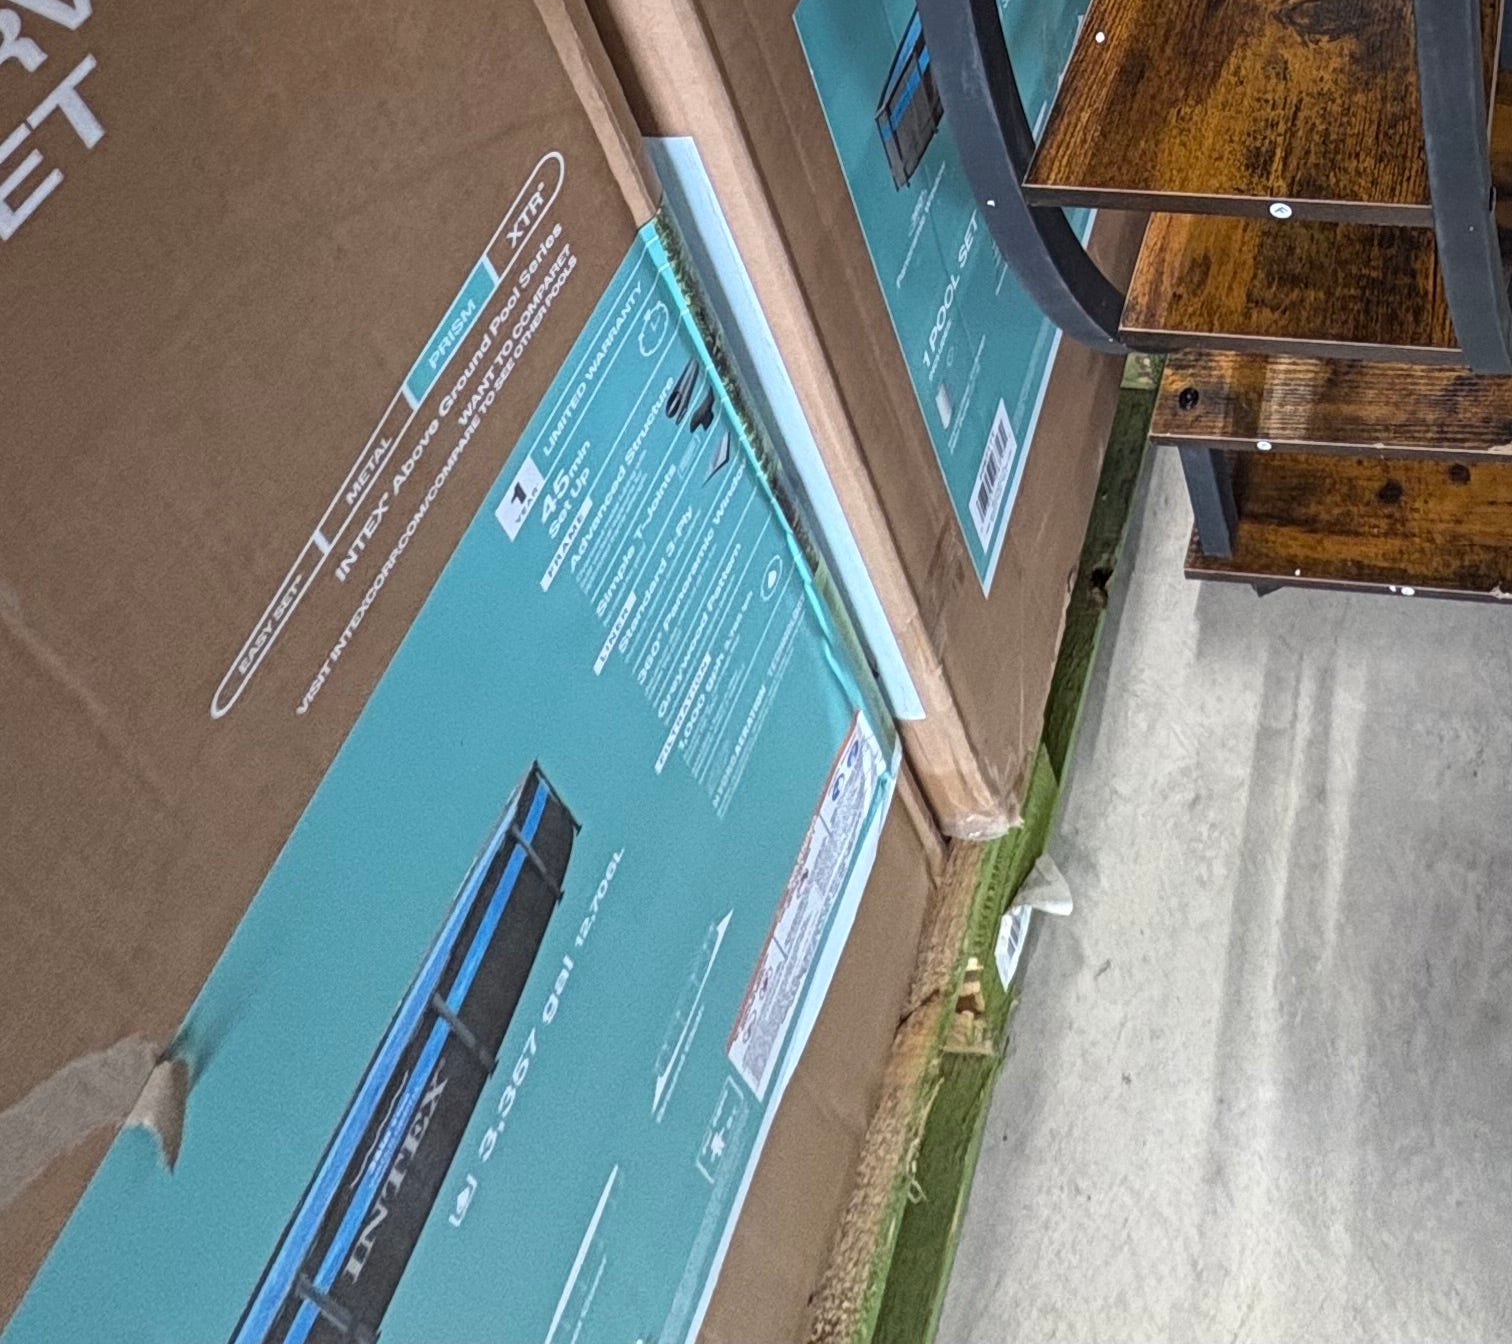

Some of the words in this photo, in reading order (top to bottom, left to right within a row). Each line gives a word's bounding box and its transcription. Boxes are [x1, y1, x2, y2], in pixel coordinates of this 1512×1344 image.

[506, 188, 544, 248] XTR
[929, 273, 960, 348] POOL
[958, 209, 979, 267] SET
[429, 298, 477, 369] PRISM
[458, 367, 496, 427] WANT
[493, 340, 514, 367] TO
[512, 244, 571, 339] COMPARE?
[543, 382, 587, 457] LIMITED
[584, 279, 643, 380] WARRANTY
[335, 496, 389, 582] INTEX
[393, 419, 440, 496] Above
[438, 333, 492, 417] Ground
[489, 286, 521, 338] Pool
[519, 223, 563, 289] Series
[297, 658, 332, 715] VISIT
[477, 389, 496, 417] TO
[495, 360, 515, 391] SEE
[513, 304, 549, 360] OTHER
[545, 255, 578, 308] POOLS
[345, 436, 392, 505] METAL
[511, 482, 527, 505] 1
[515, 486, 539, 525] YEAR
[541, 440, 591, 525] 45min
[549, 497, 572, 540] Set
[569, 467, 590, 499] Up
[570, 464, 626, 573] Advanced
[623, 376, 674, 466] Structure
[548, 511, 585, 579] FRAME
[596, 544, 635, 619] Simple
[633, 463, 677, 540] T-Joints
[662, 527, 715, 631] Panoramic
[238, 618, 276, 674] EASY
[272, 573, 301, 619] SET
[599, 607, 630, 662] LINER
[618, 556, 667, 654] Standard
[657, 610, 710, 719] Greywood
[478, 1027, 538, 1164] 3,357
[541, 953, 574, 1026] gal
[342, 1056, 449, 1286] INTEX
